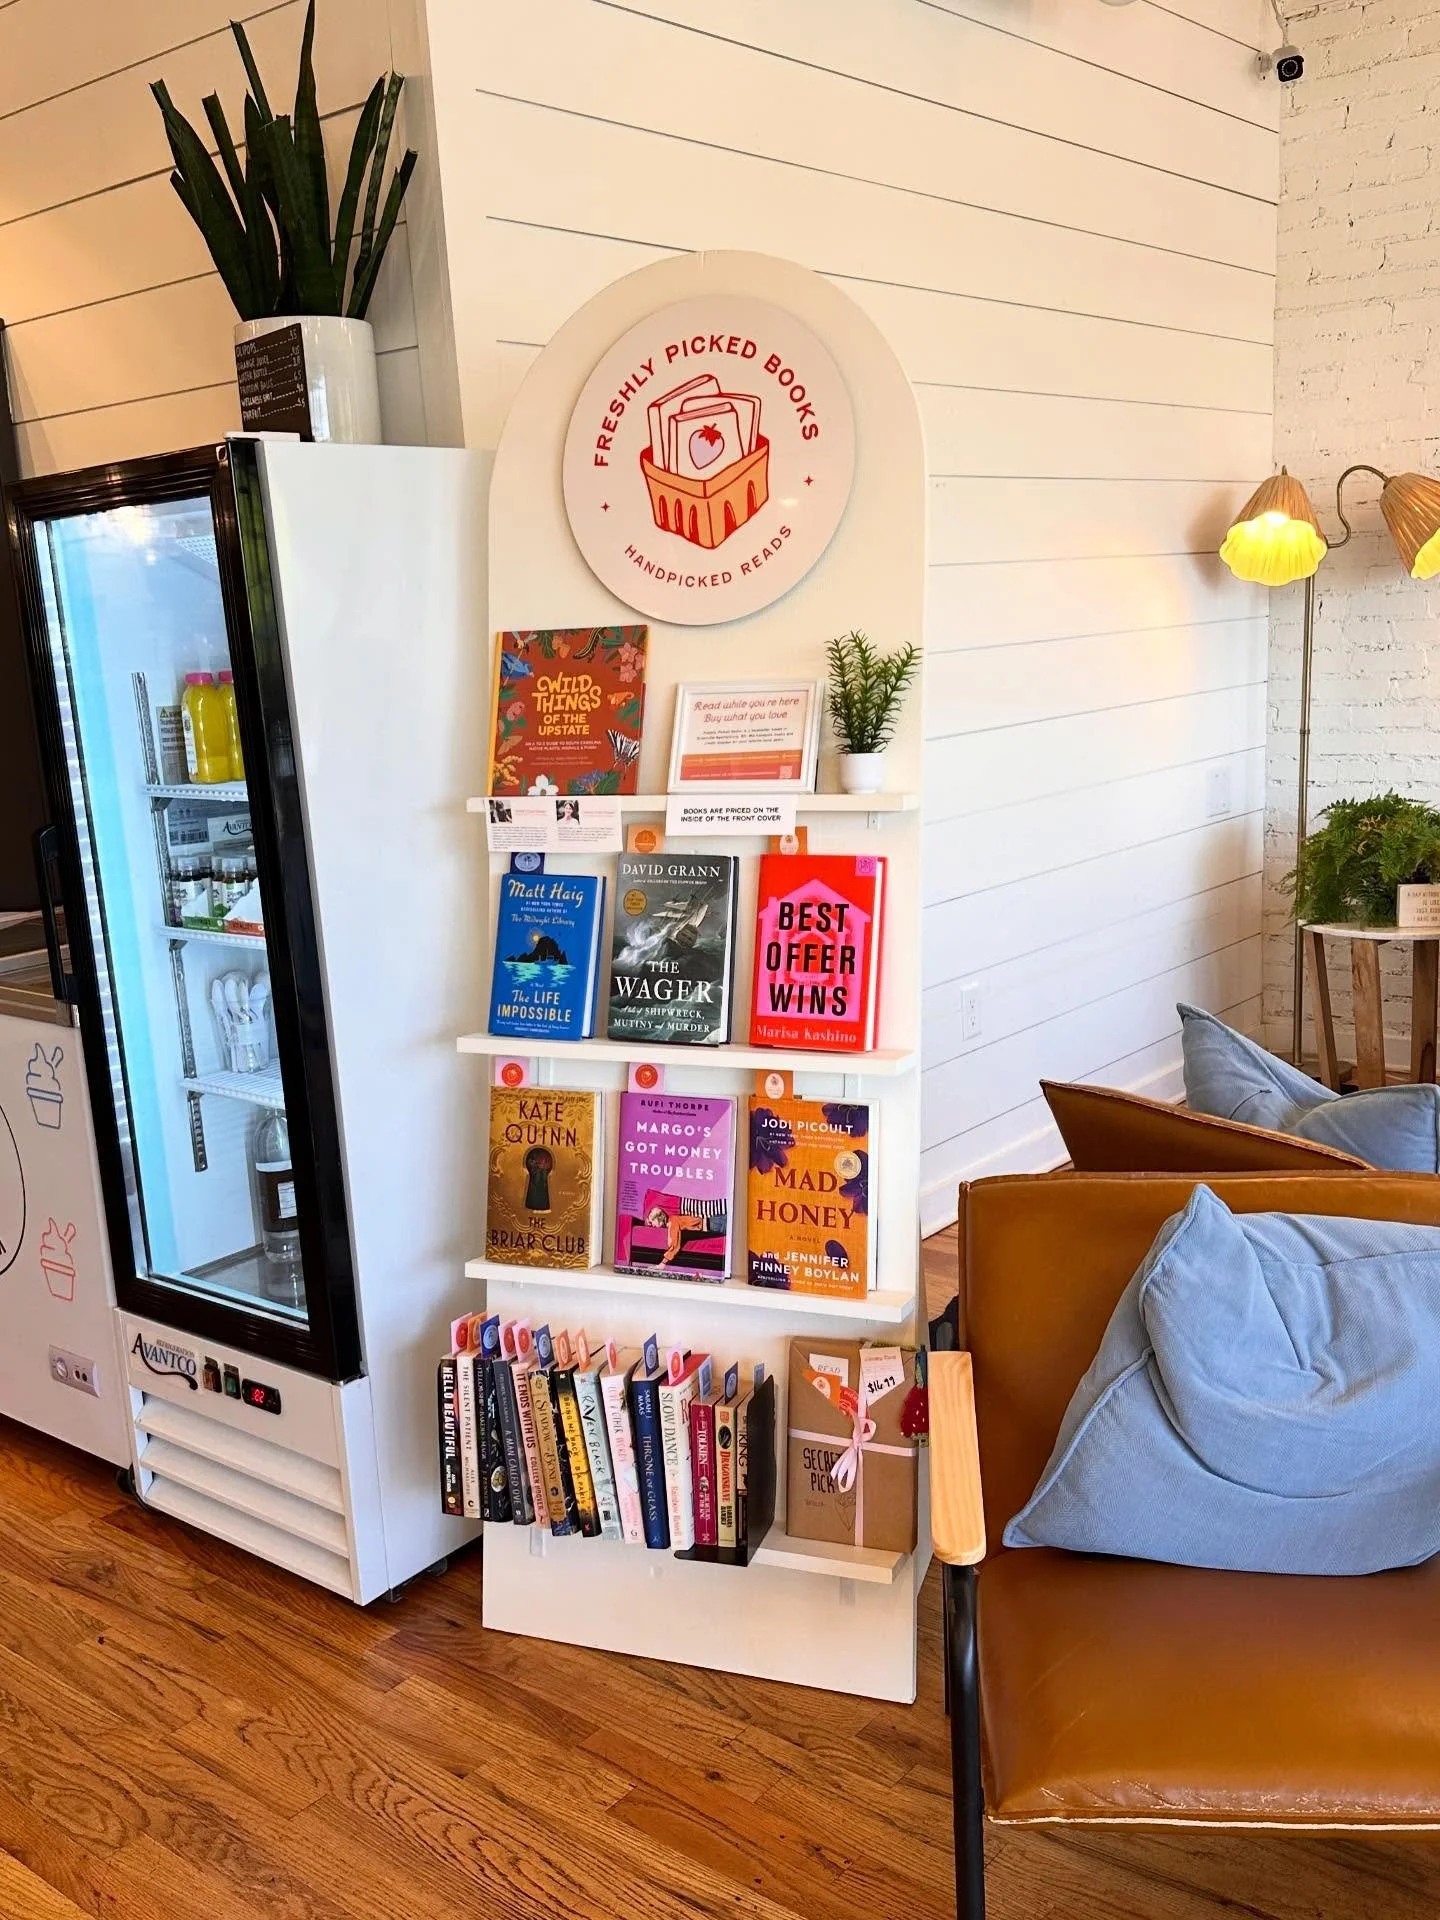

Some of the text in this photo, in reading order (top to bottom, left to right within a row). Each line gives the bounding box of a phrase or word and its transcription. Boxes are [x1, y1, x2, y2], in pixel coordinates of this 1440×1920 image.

[594, 334, 819, 467] FRESHLY PICKED BOOKS
[624, 525, 792, 588] HANDPICKED READS
[537, 672, 593, 694] WILD
[532, 686, 602, 713] THINGS
[694, 701, 720, 711] Read
[723, 699, 747, 710] while
[780, 697, 800, 707] here
[544, 714, 587, 725] OF THE
[704, 711, 788, 724] Buy what you love
[539, 725, 590, 736] UPSTATE
[623, 864, 721, 878] DAVID GRANN
[508, 879, 584, 909] Matt Haig
[511, 914, 521, 923] The
[552, 916, 575, 928] Library
[778, 902, 850, 933] BEST
[650, 961, 680, 974] THE
[766, 941, 856, 975] OFFER
[512, 990, 561, 1005] The LIFE
[614, 977, 714, 1004] WAGER
[770, 983, 848, 1017] WINS
[497, 1004, 572, 1023] IMPOSSIBLE
[644, 1007, 705, 1020] SHIPWRECK,
[614, 1018, 654, 1029] MUTINY
[666, 1023, 710, 1033] MURDER
[756, 1024, 857, 1044] Marisa Kashino
[519, 1100, 564, 1122] KATE
[641, 1100, 709, 1112] RUFI THORPE
[505, 1124, 577, 1147] QUINN
[636, 1121, 712, 1138] MARGO'S
[762, 1118, 854, 1135] JODI PICOULT
[625, 1141, 722, 1160] GOT MONEY
[630, 1162, 714, 1181] TROUBLES
[774, 1167, 838, 1193] MAD
[528, 1216, 546, 1230] THE
[756, 1200, 855, 1230] HONEY
[490, 1230, 585, 1255] BRIAR CLUB
[784, 1252, 849, 1268] JENNIFER
[752, 1261, 859, 1283] FINNEY BOYLAN
[131, 1333, 197, 1376] AVANTCO
[442, 1366, 456, 1459] HELLO BEAUTIFUL
[517, 1373, 536, 1449] IT ENDS WITH US
[637, 1395, 645, 1415] MAAS
[644, 1389, 652, 1413] SARAH
[563, 1396, 579, 1457] BRING ME BACK
[582, 1396, 605, 1474] RAVEN BLACK
[661, 1393, 679, 1466] SLOW DANCE
[507, 1438, 515, 1456] MAN
[535, 1399, 557, 1481] SHADOW BONE
[697, 1429, 708, 1465] TOLKIEN
[738, 1434, 748, 1467] KING
[509, 1459, 520, 1487] CALLED
[530, 1457, 544, 1511] COLLEEN HOOVER
[642, 1435, 658, 1521] THRONE GLASS
[720, 1451, 731, 1503] DRAGONSBANE
[811, 1472, 835, 1494] PICK
[512, 1489, 522, 1505] OVE
[671, 1486, 682, 1537] Rainbow Rowell
